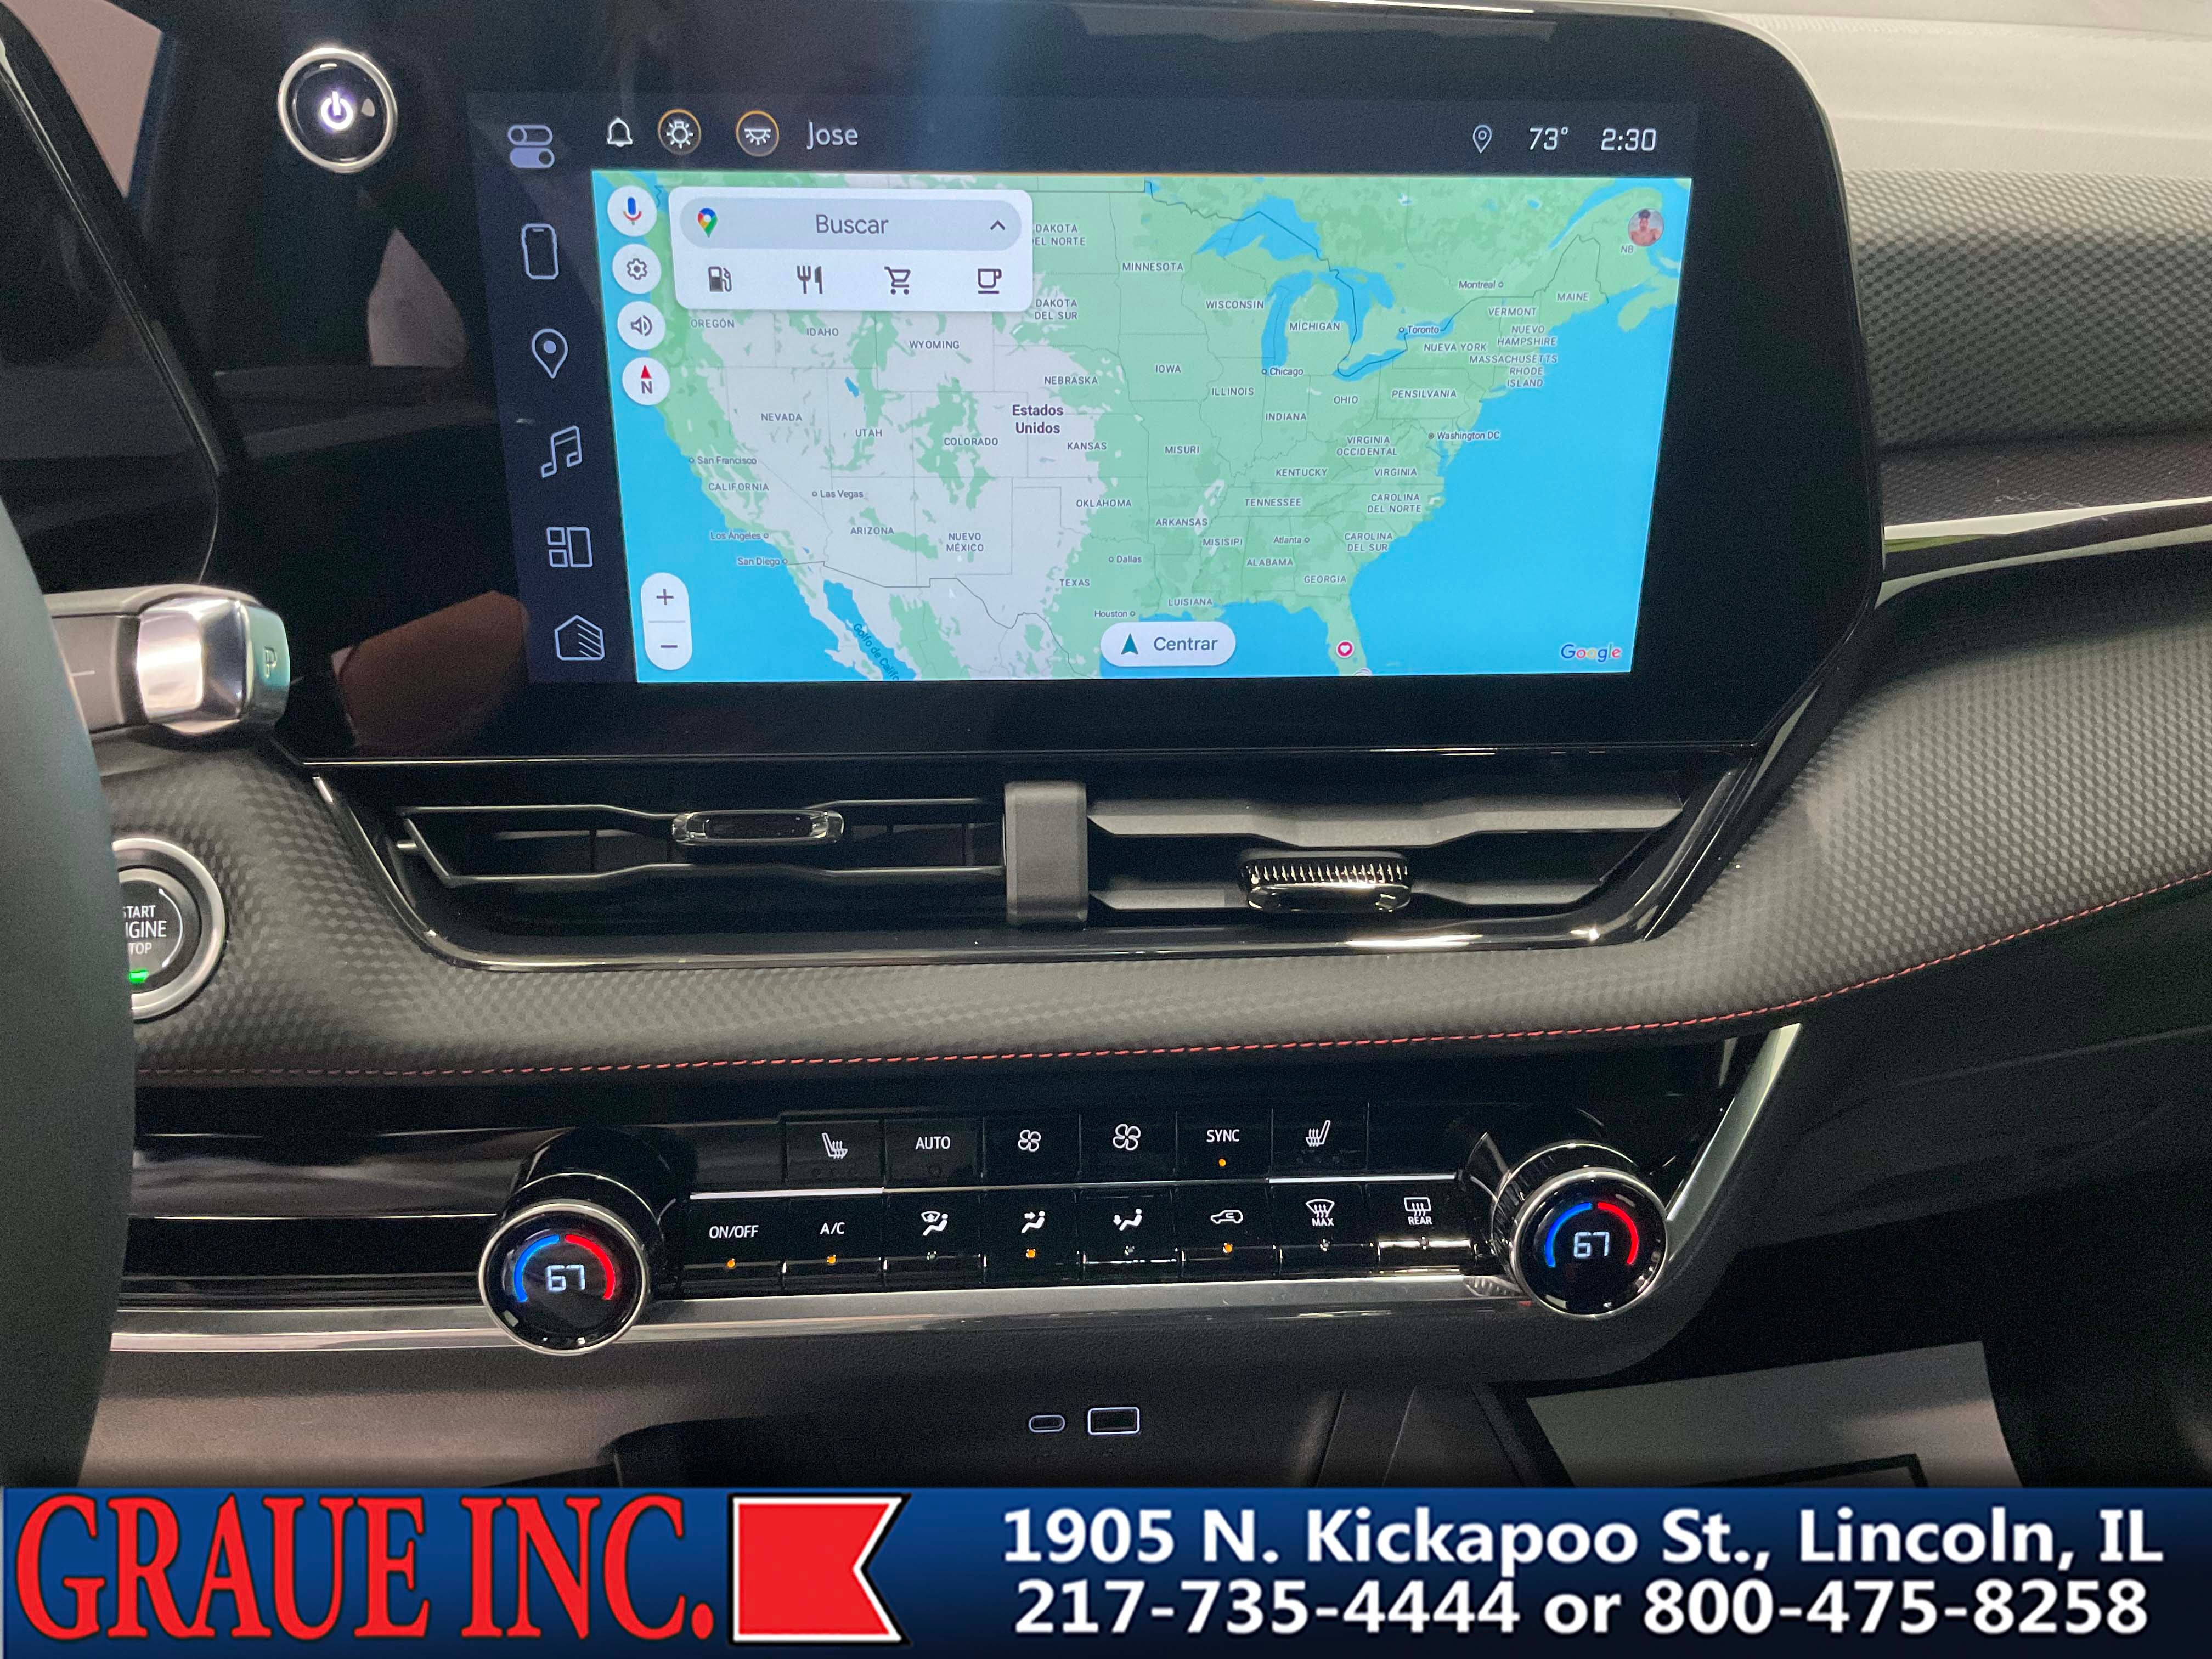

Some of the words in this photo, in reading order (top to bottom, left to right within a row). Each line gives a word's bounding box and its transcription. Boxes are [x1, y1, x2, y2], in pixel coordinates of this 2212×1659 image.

[807, 120, 858, 150] Jose
[1530, 127, 1568, 150] 73°
[1601, 128, 1656, 151] 2:30
[816, 215, 889, 235] Buscar
[1036, 224, 1077, 233] DAKOTA
[1032, 237, 1046, 245] EL
[1051, 237, 1085, 245] NORTE
[1122, 262, 1183, 272] MINNESOTA
[1459, 280, 1496, 289] Montreal
[1557, 292, 1589, 301] MAINE
[1036, 299, 1077, 307] DAKOTA
[1206, 300, 1264, 309] WISCONSIN
[1035, 311, 1053, 320] DEL
[1058, 311, 1077, 320] SUR
[1488, 307, 1536, 316] VERMONT
[691, 317, 735, 328] OREGÓN
[806, 328, 839, 336] IDAHO
[1407, 325, 1439, 334] Toronto
[1511, 325, 1545, 334] NUEVO
[909, 340, 960, 349] WYOMING
[1497, 337, 1557, 346] HAMPSHIRE
[1424, 343, 1456, 352] NUEVA
[1460, 343, 1487, 352] YORK
[1469, 354, 1558, 364] MASSACHUSETTS
[1155, 365, 1181, 373] IOWA
[1269, 367, 1304, 377] Chicago
[1509, 367, 1543, 376] RHODE
[1045, 376, 1098, 385] NEBRASKA
[1507, 379, 1543, 387] ISLAND
[641, 381, 652, 394] N
[1211, 387, 1254, 396] ILLINOIS
[1392, 390, 1457, 398] PENSILVANIA
[1334, 396, 1358, 404] OHIO
[1012, 404, 1063, 416] Estados
[761, 413, 803, 421] NEVADA
[1265, 413, 1307, 421] INDIANA
[1015, 422, 1060, 434] Unidos
[855, 429, 883, 437] UTAH
[1437, 431, 1485, 441] Washington
[1487, 431, 1500, 439] DC
[944, 437, 998, 446] COLORADO
[1347, 436, 1390, 444] VIRGINIA
[1165, 446, 1200, 454] MISURI
[1336, 448, 1397, 456] OCCIDENTAL
[1276, 469, 1328, 477] KENTUCKY
[1374, 468, 1417, 476] VIRGINIA
[708, 483, 769, 491] CALIFORNIA
[837, 490, 864, 499] Vegas
[1371, 494, 1420, 502] CAROLINA
[1076, 499, 1132, 507] OKLAHOMA
[1245, 498, 1301, 506] TENNESSEE
[1367, 505, 1385, 513] DEL
[1389, 505, 1421, 513] NORTE
[1155, 518, 1207, 527] ARKANSAS
[711, 532, 726, 540] Los
[728, 530, 761, 541] Ángeles
[949, 533, 981, 541] NUEVO
[1273, 536, 1302, 544] Atlanta
[946, 542, 984, 552] MÉXICO
[1347, 544, 1365, 552] DEL
[1369, 543, 1388, 551] SUR
[756, 557, 780, 567] Diego
[1116, 555, 1142, 563] Dallas
[1246, 558, 1294, 567] ALABAMA
[1059, 579, 1090, 587] TEXAS
[1304, 575, 1346, 583] GEORGIA
[1168, 598, 1212, 606] LUISIANA
[854, 623, 872, 646] Golfo
[871, 647, 881, 658] de
[1154, 637, 1218, 651] Centrar
[1560, 643, 1621, 663] Google
[126, 921, 167, 938] GINE
[128, 943, 152, 955] TOP
[1206, 1129, 1240, 1143] SYNC
[916, 1136, 950, 1150] AUTO
[1312, 1218, 1334, 1226] MAX
[1408, 1216, 1432, 1225] REAR
[709, 1225, 759, 1238] ON/OFF
[820, 1222, 845, 1234] A/C
[1573, 1232, 1610, 1257] 67
[546, 1264, 585, 1291] 67
